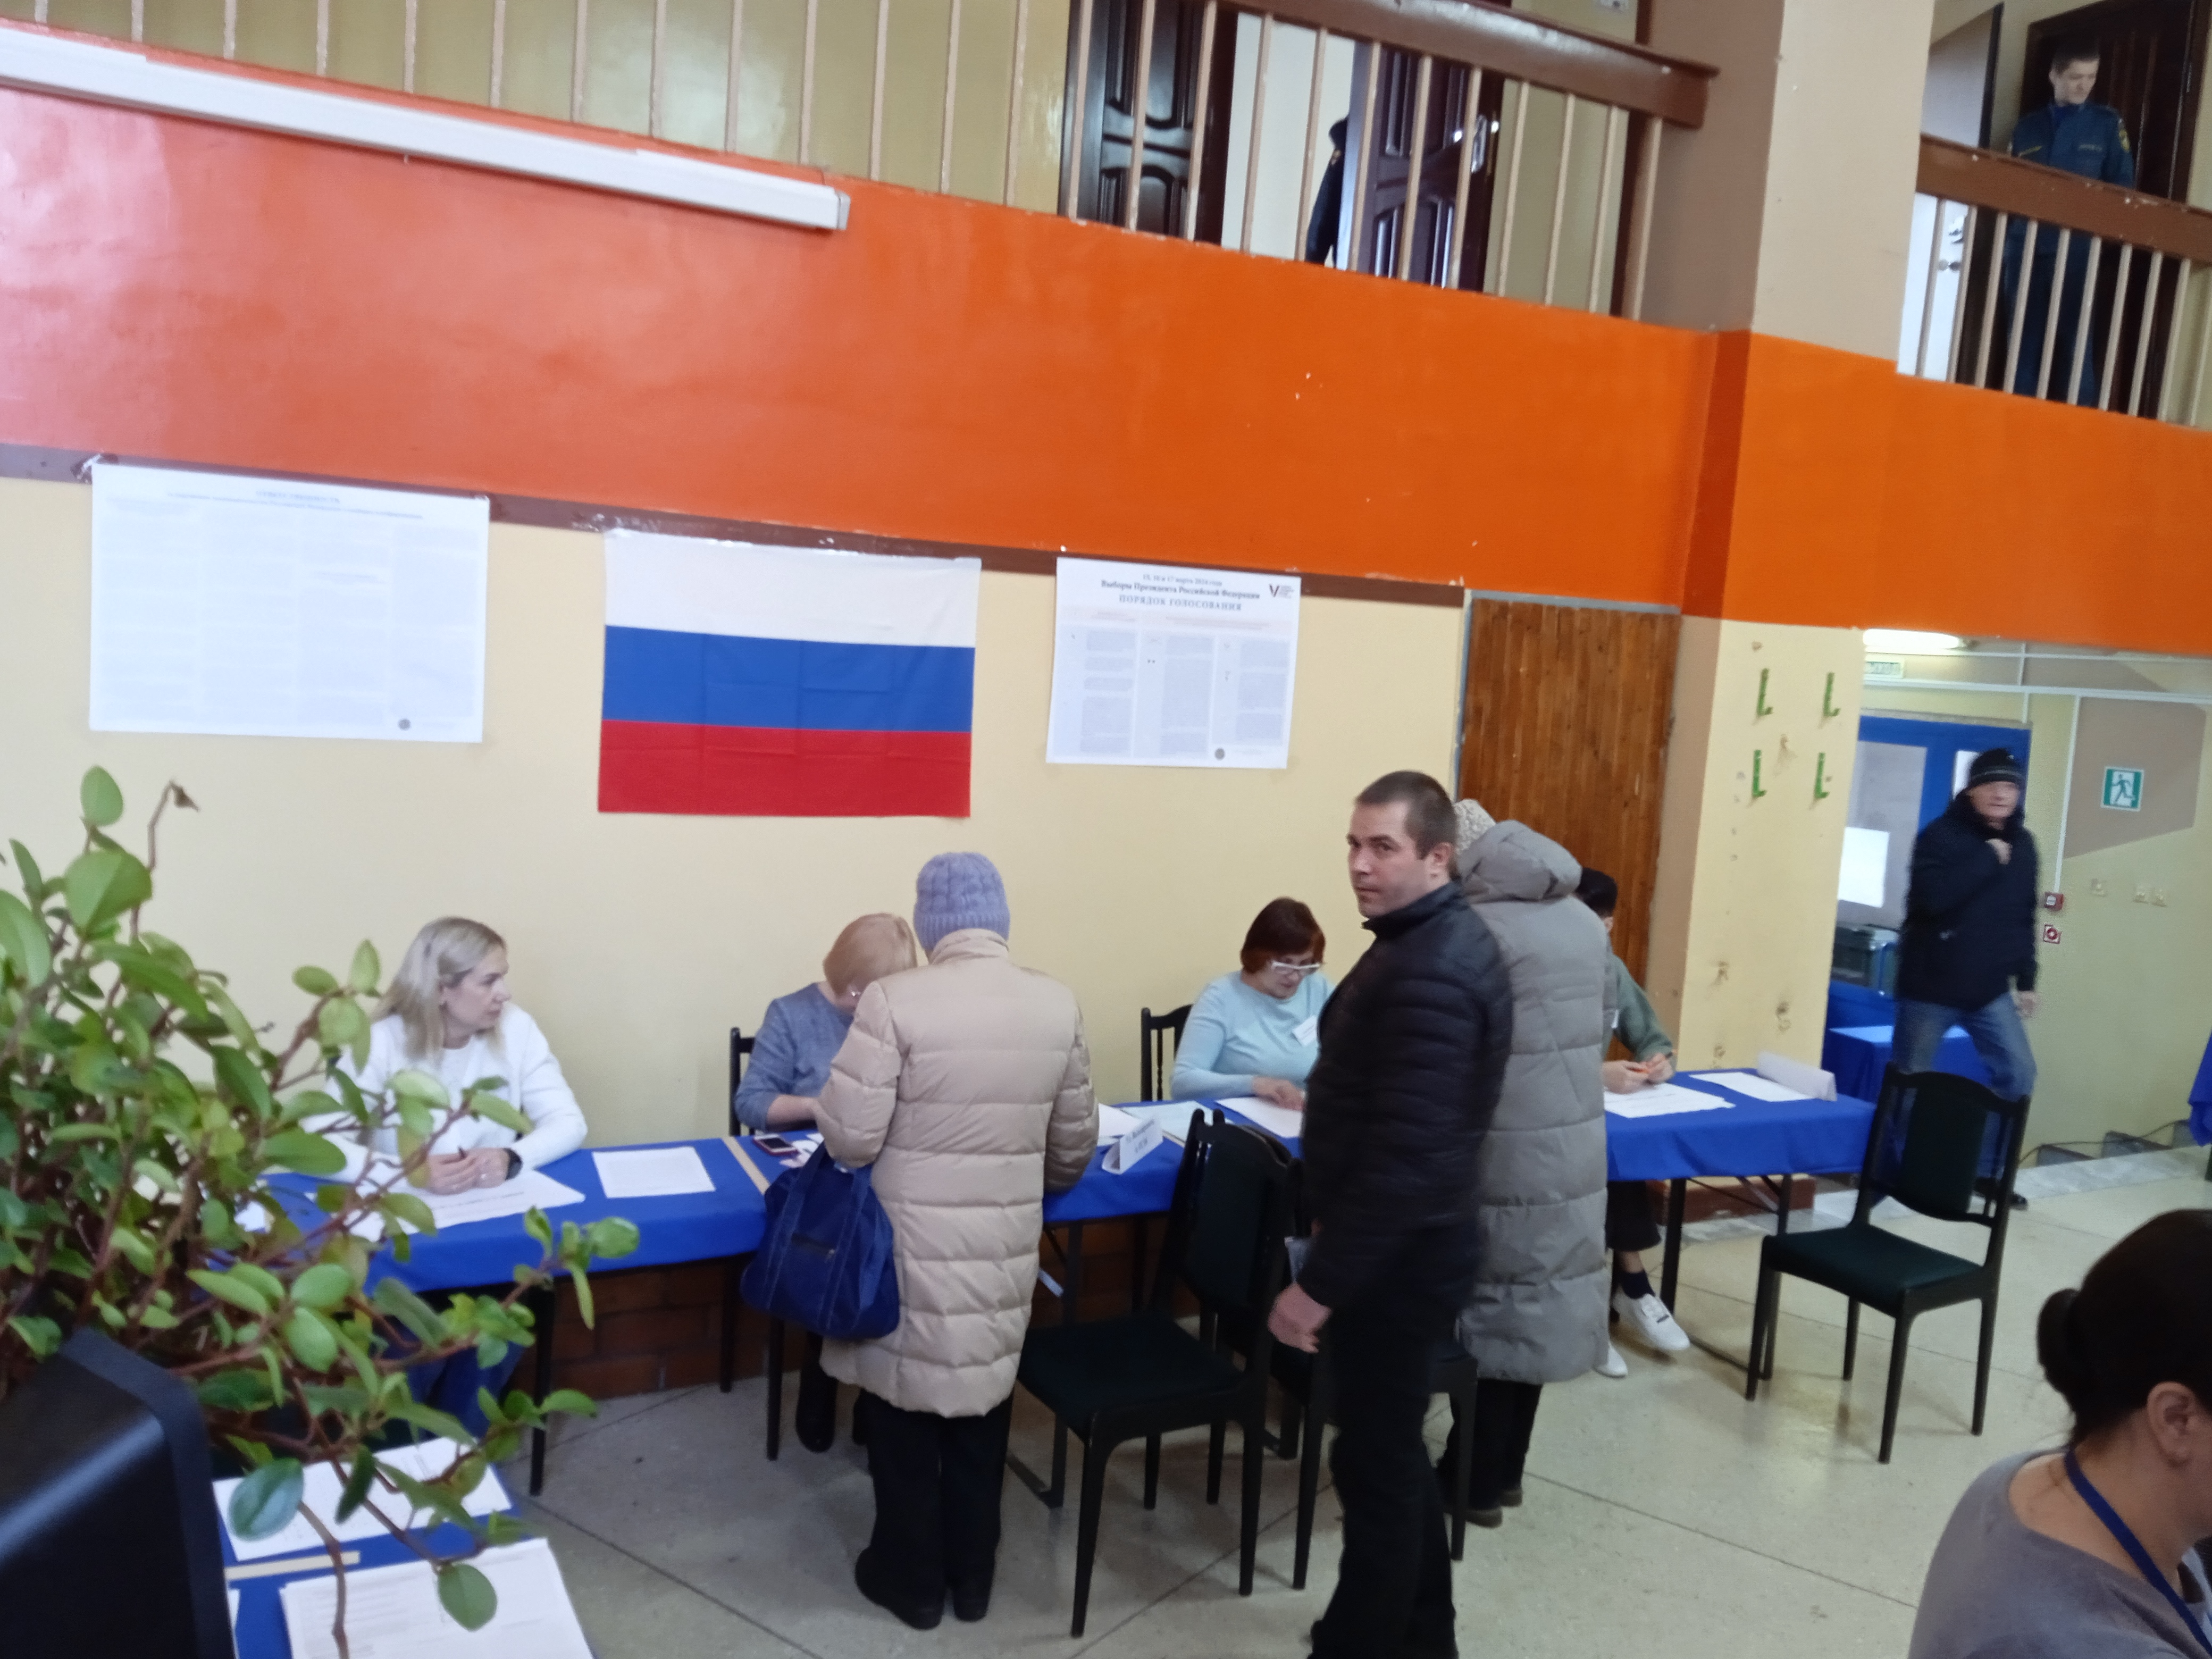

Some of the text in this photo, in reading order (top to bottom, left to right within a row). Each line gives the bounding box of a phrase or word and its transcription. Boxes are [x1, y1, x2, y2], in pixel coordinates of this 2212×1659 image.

[1101, 580, 1260, 599] Выборы Президента Российской Федерации
[1119, 594, 1242, 610] ПОРЯДОК ГОЛОСОВАНИЯ
